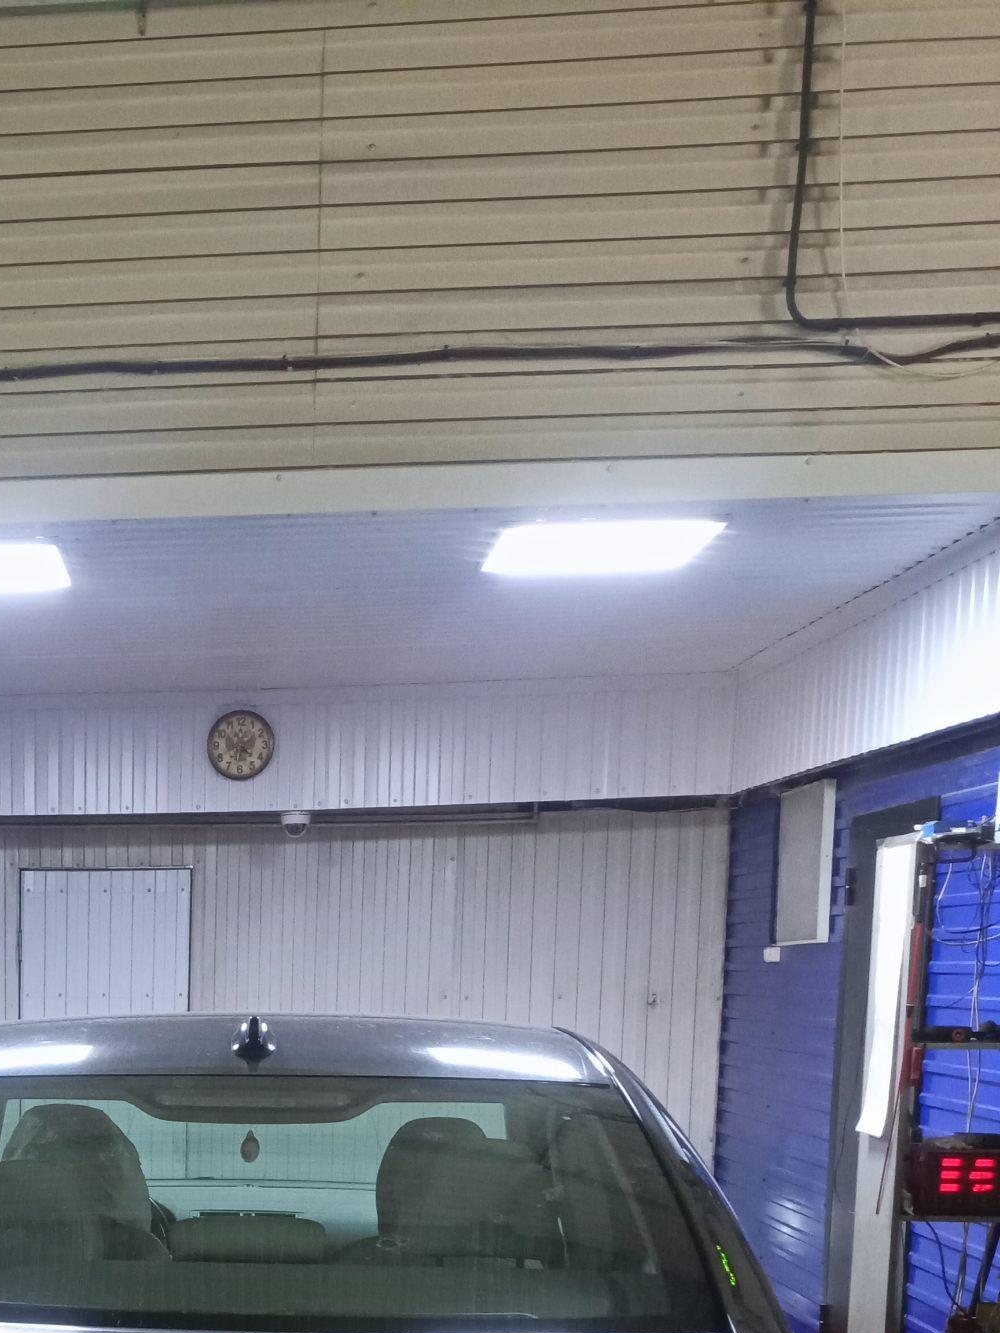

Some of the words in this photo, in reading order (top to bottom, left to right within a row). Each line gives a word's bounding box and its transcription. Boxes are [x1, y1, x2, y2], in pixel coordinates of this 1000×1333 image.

[236, 717, 247, 727] 12
[225, 761, 232, 771] 7
[236, 765, 243, 774] 6
